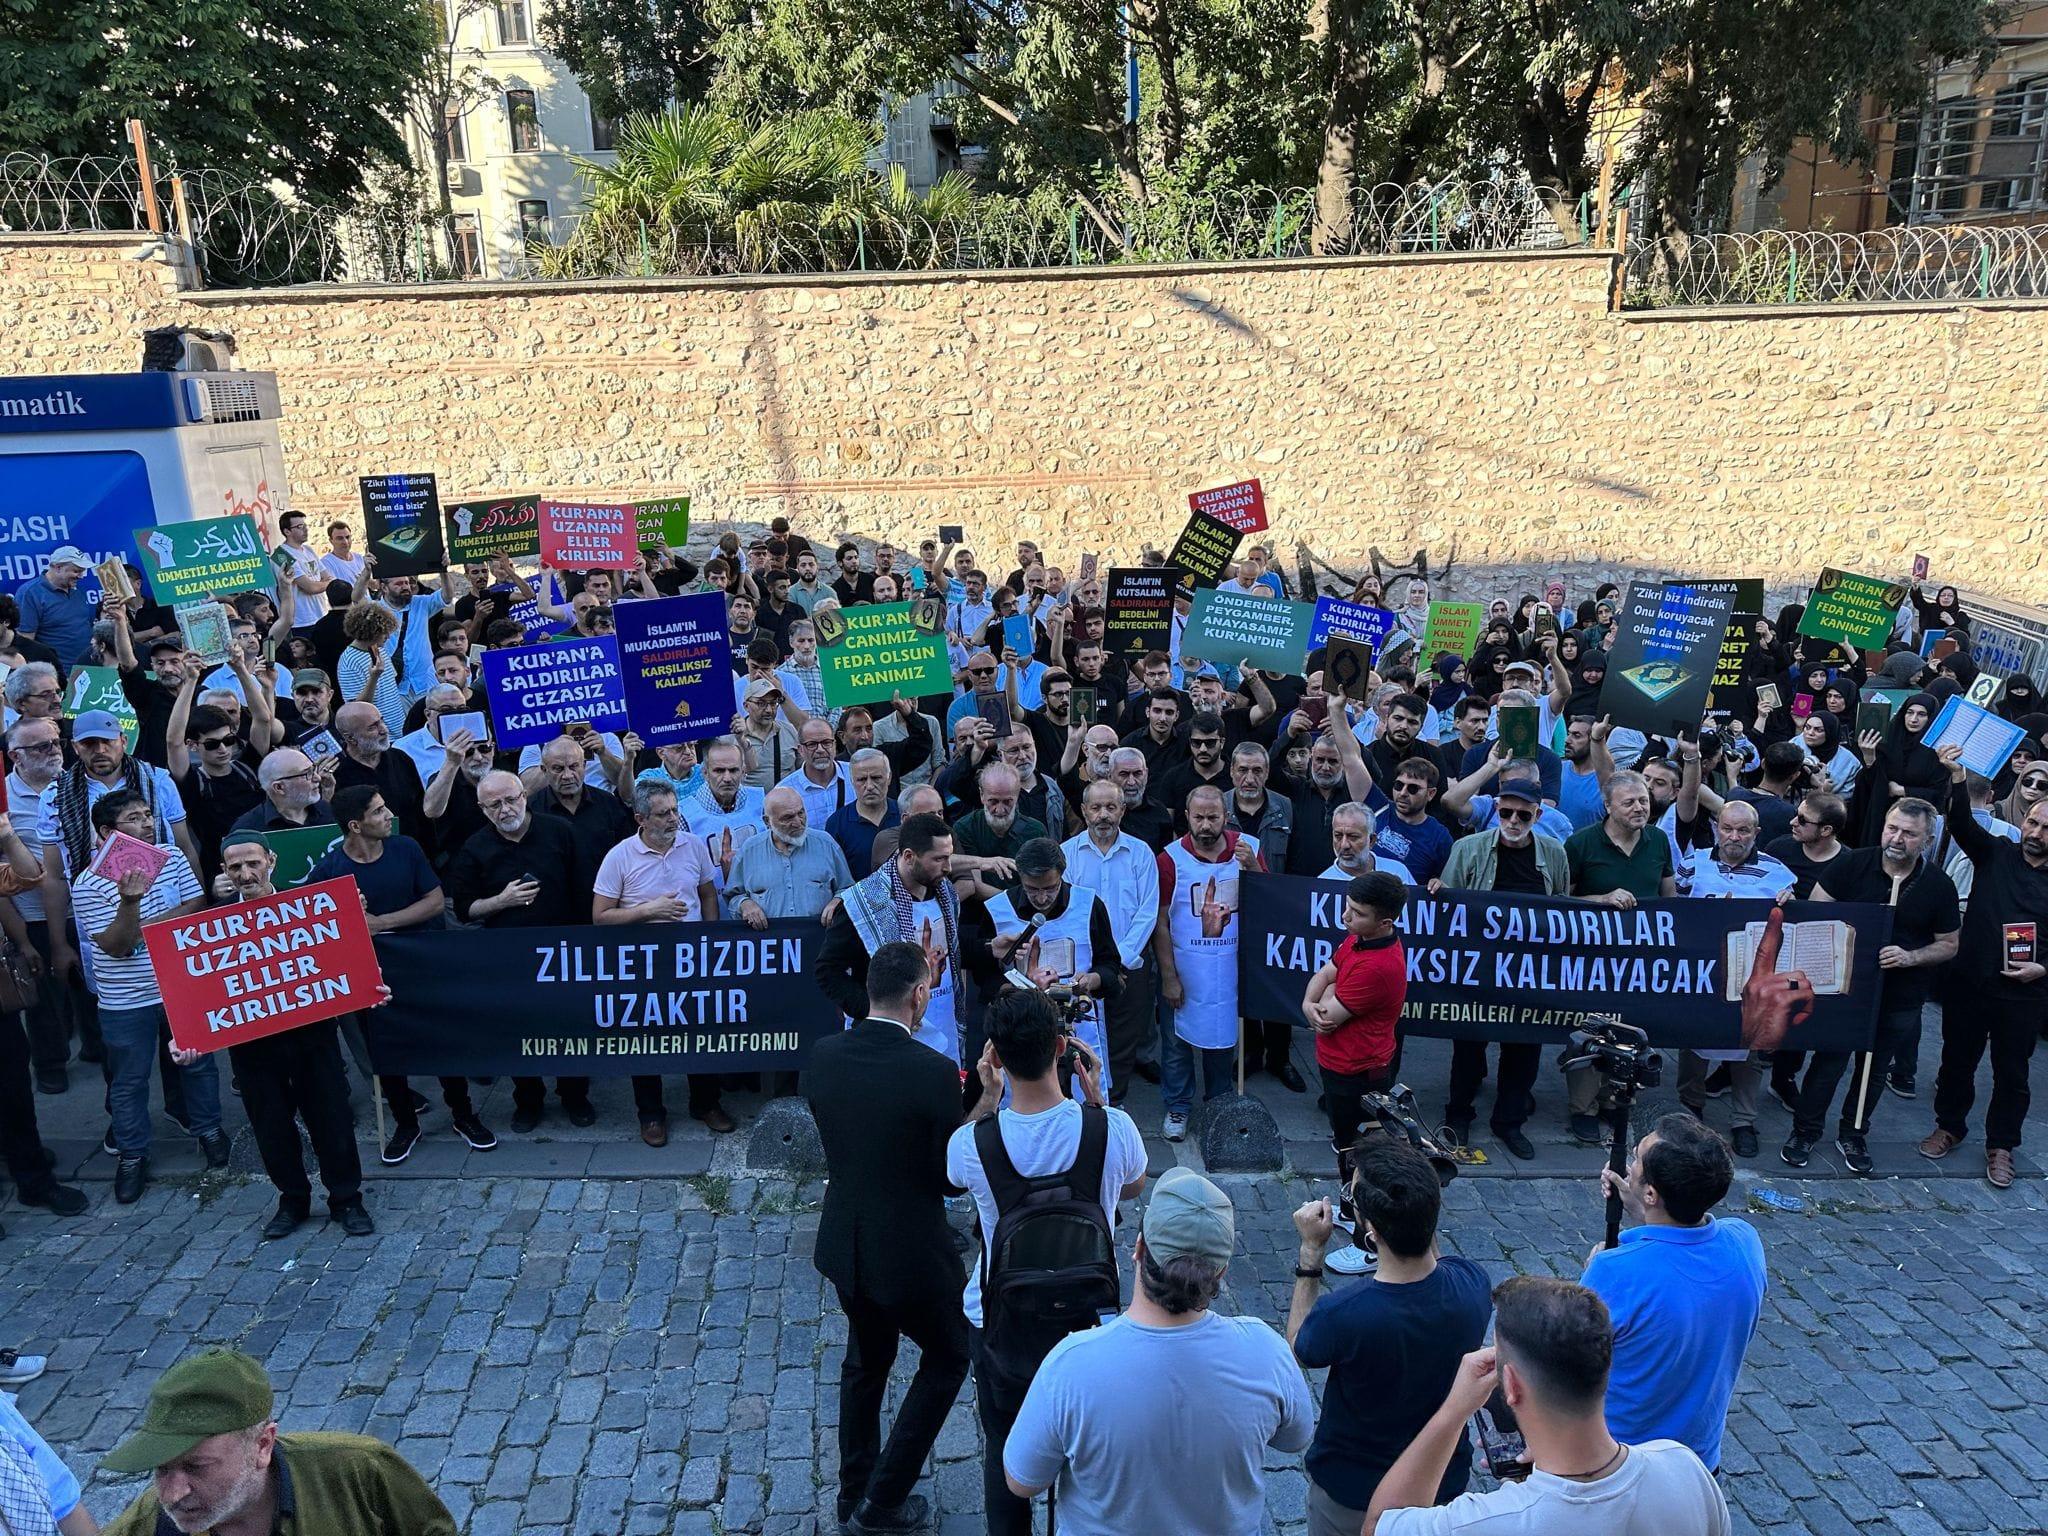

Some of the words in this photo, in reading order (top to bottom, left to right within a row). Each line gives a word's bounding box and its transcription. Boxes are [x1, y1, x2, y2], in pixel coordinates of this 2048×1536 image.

[0, 391, 88, 416] matik
[388, 478, 400, 487] biz
[401, 476, 432, 486] indirdik
[369, 492, 386, 500] Onu
[387, 489, 430, 500] koruyacak
[1197, 484, 1254, 504] KUR'AN'A
[374, 504, 392, 512] olan
[393, 503, 405, 511] da
[550, 506, 624, 520] KUR'AN'A
[1213, 509, 1246, 522] LLER
[552, 520, 623, 534] UZANAN
[637, 531, 666, 543] EDA
[1194, 517, 1234, 546] İSLAM'A
[567, 535, 611, 547] ELLER
[1184, 529, 1232, 558] HAKARET
[556, 549, 623, 561] KIRILSIN
[1181, 542, 1223, 569] CEZASIZ
[157, 564, 208, 583] ÜMMETİZ
[211, 557, 263, 576] KARDEŞİZ
[1175, 552, 1217, 580] KALMAZ
[175, 573, 256, 596] KAZANACAĞIZ
[1123, 575, 1162, 586] İSLAM'IN
[1840, 579, 1885, 598] KUR'AN
[1116, 588, 1166, 597] KUTSALINA
[1633, 586, 1663, 600] "Zikri
[1665, 591, 1681, 604] biz
[1683, 595, 1727, 610] indirdik
[1831, 591, 1882, 611] CANIMIZ
[1119, 609, 1159, 619] BEDELİNİ
[1214, 594, 1293, 614] ÖNDERİMİZ
[1329, 603, 1381, 623] KUR'AN'A
[1816, 601, 1844, 616] FEDA
[1846, 608, 1886, 626] OLSUN
[846, 611, 910, 630] KUR'AN
[1107, 619, 1169, 630] ÖDEYECEKTİR
[1202, 616, 1294, 637] ANAYASAMIZ
[1205, 605, 1295, 627] PEYGAMBER,
[1320, 613, 1383, 635] SALDIRILAR
[1634, 605, 1655, 618] Onu
[1657, 609, 1715, 627] koruyacak
[1820, 616, 1872, 637] KANIMIZ
[647, 620, 697, 636] İSLAM'IN
[1204, 627, 1286, 649] KUR'AN'DIR
[1633, 624, 1656, 636] olan
[1658, 627, 1673, 638] da
[1675, 629, 1707, 643] biziz"
[624, 631, 722, 653] MUKADDESATINA
[845, 629, 919, 649] CANIMIZ
[507, 645, 604, 672] KUR'AN'A
[642, 646, 708, 664] SALDIRILAR
[833, 653, 875, 670] FEDA
[879, 646, 935, 665] OLSUN
[501, 663, 617, 692] SALDIRILAR
[641, 659, 712, 678] KARŞILIKSIZ
[850, 666, 926, 687] KANIMIZ
[655, 673, 702, 689] KALMAZ
[522, 683, 605, 708] CEZASIZ
[505, 698, 627, 731] KALMAMALI
[650, 722, 688, 734] ÜMMET-İ
[689, 716, 720, 728] VAHİDE
[172, 892, 338, 951] KUR'AN'A
[1483, 905, 1676, 948] SALDIRILAR
[186, 919, 341, 977] UZANAN
[536, 940, 659, 982] ZİLLET
[675, 935, 802, 980] BİZDEN
[223, 955, 322, 998] ELLER
[1495, 951, 1717, 995] KALMAYACAK
[205, 974, 351, 1033] KIRILSIN
[594, 988, 748, 1028] UZAKTIR
[1430, 1002, 1516, 1024] FEDAİLERİ
[521, 1036, 589, 1056] KUR'AN
[596, 1032, 688, 1055] FEDAİLERİ
[696, 1031, 800, 1053] PLATFORMU
